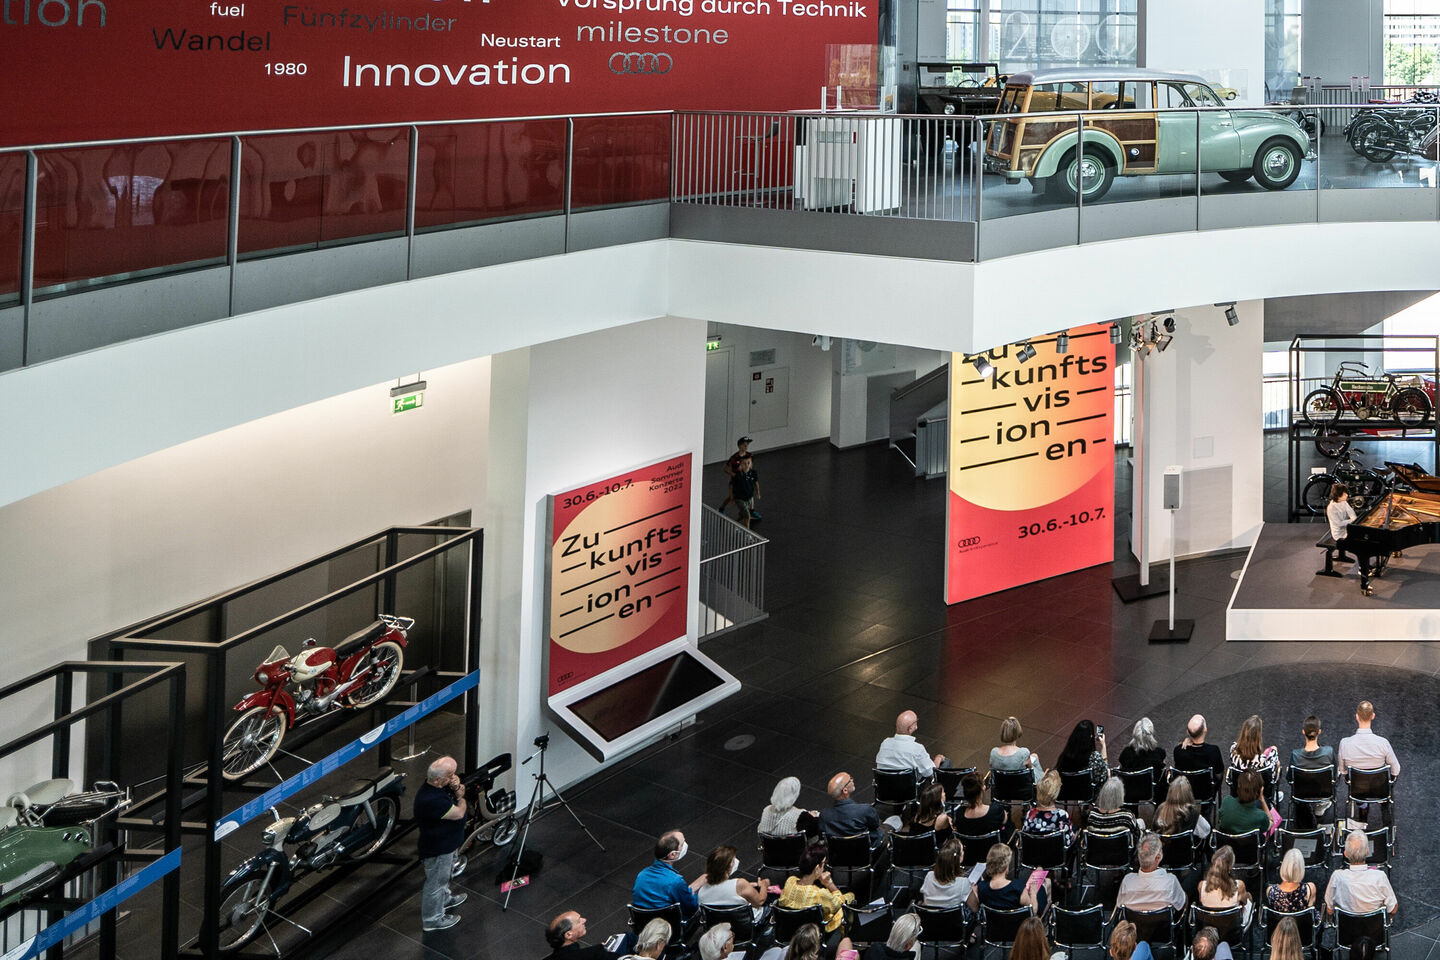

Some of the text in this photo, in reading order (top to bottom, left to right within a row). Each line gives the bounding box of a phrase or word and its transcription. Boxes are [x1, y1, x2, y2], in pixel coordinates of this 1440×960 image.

[209, 1, 245, 18] fuel
[283, 4, 457, 34] Fünfzylinder
[777, 0, 867, 18] Technik
[152, 26, 271, 53] Wandel
[480, 32, 561, 49] Neustart
[576, 20, 730, 45] milestone
[264, 62, 308, 77] 1980
[343, 55, 571, 86] Innovation
[992, 355, 1107, 390] kunfts
[1023, 387, 1070, 412] vis
[996, 419, 1050, 444] ion
[1045, 438, 1087, 461] en
[649, 477, 684, 492] Konzerte
[651, 470, 684, 484] Sommer
[664, 483, 683, 494] 2022
[563, 478, 635, 509] 30.6.-10.7.
[1018, 507, 1106, 539] 30.6.-10.7.
[561, 532, 600, 558] Zu
[590, 523, 683, 570] kunfts
[625, 552, 662, 577] vis
[587, 584, 631, 613] ion
[618, 595, 652, 619] en
